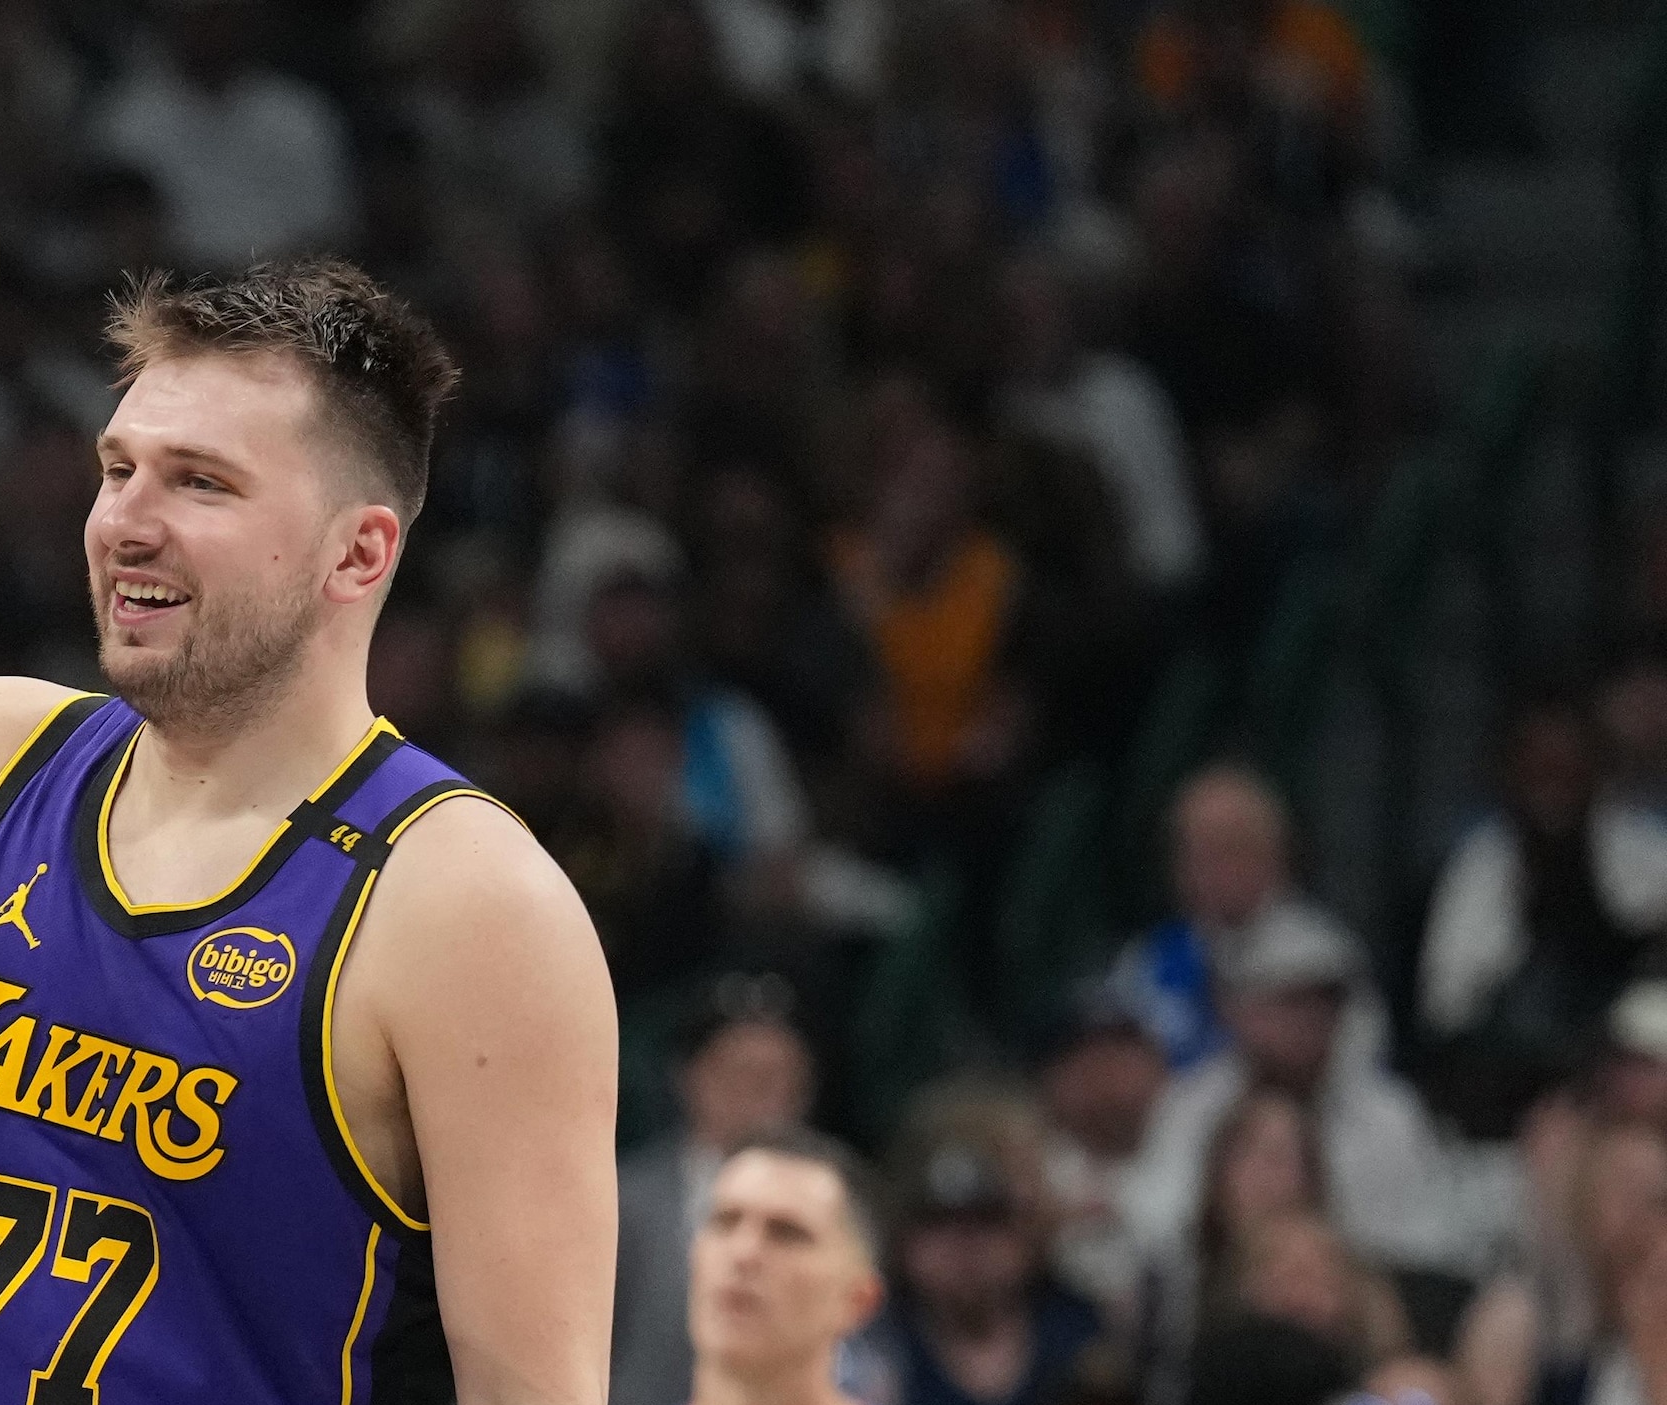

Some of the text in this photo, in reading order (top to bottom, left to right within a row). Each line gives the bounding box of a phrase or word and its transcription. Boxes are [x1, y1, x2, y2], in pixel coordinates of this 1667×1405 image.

[329, 824, 362, 853] 44
[198, 943, 288, 988] bibigo
[207, 970, 247, 991] 비비고
